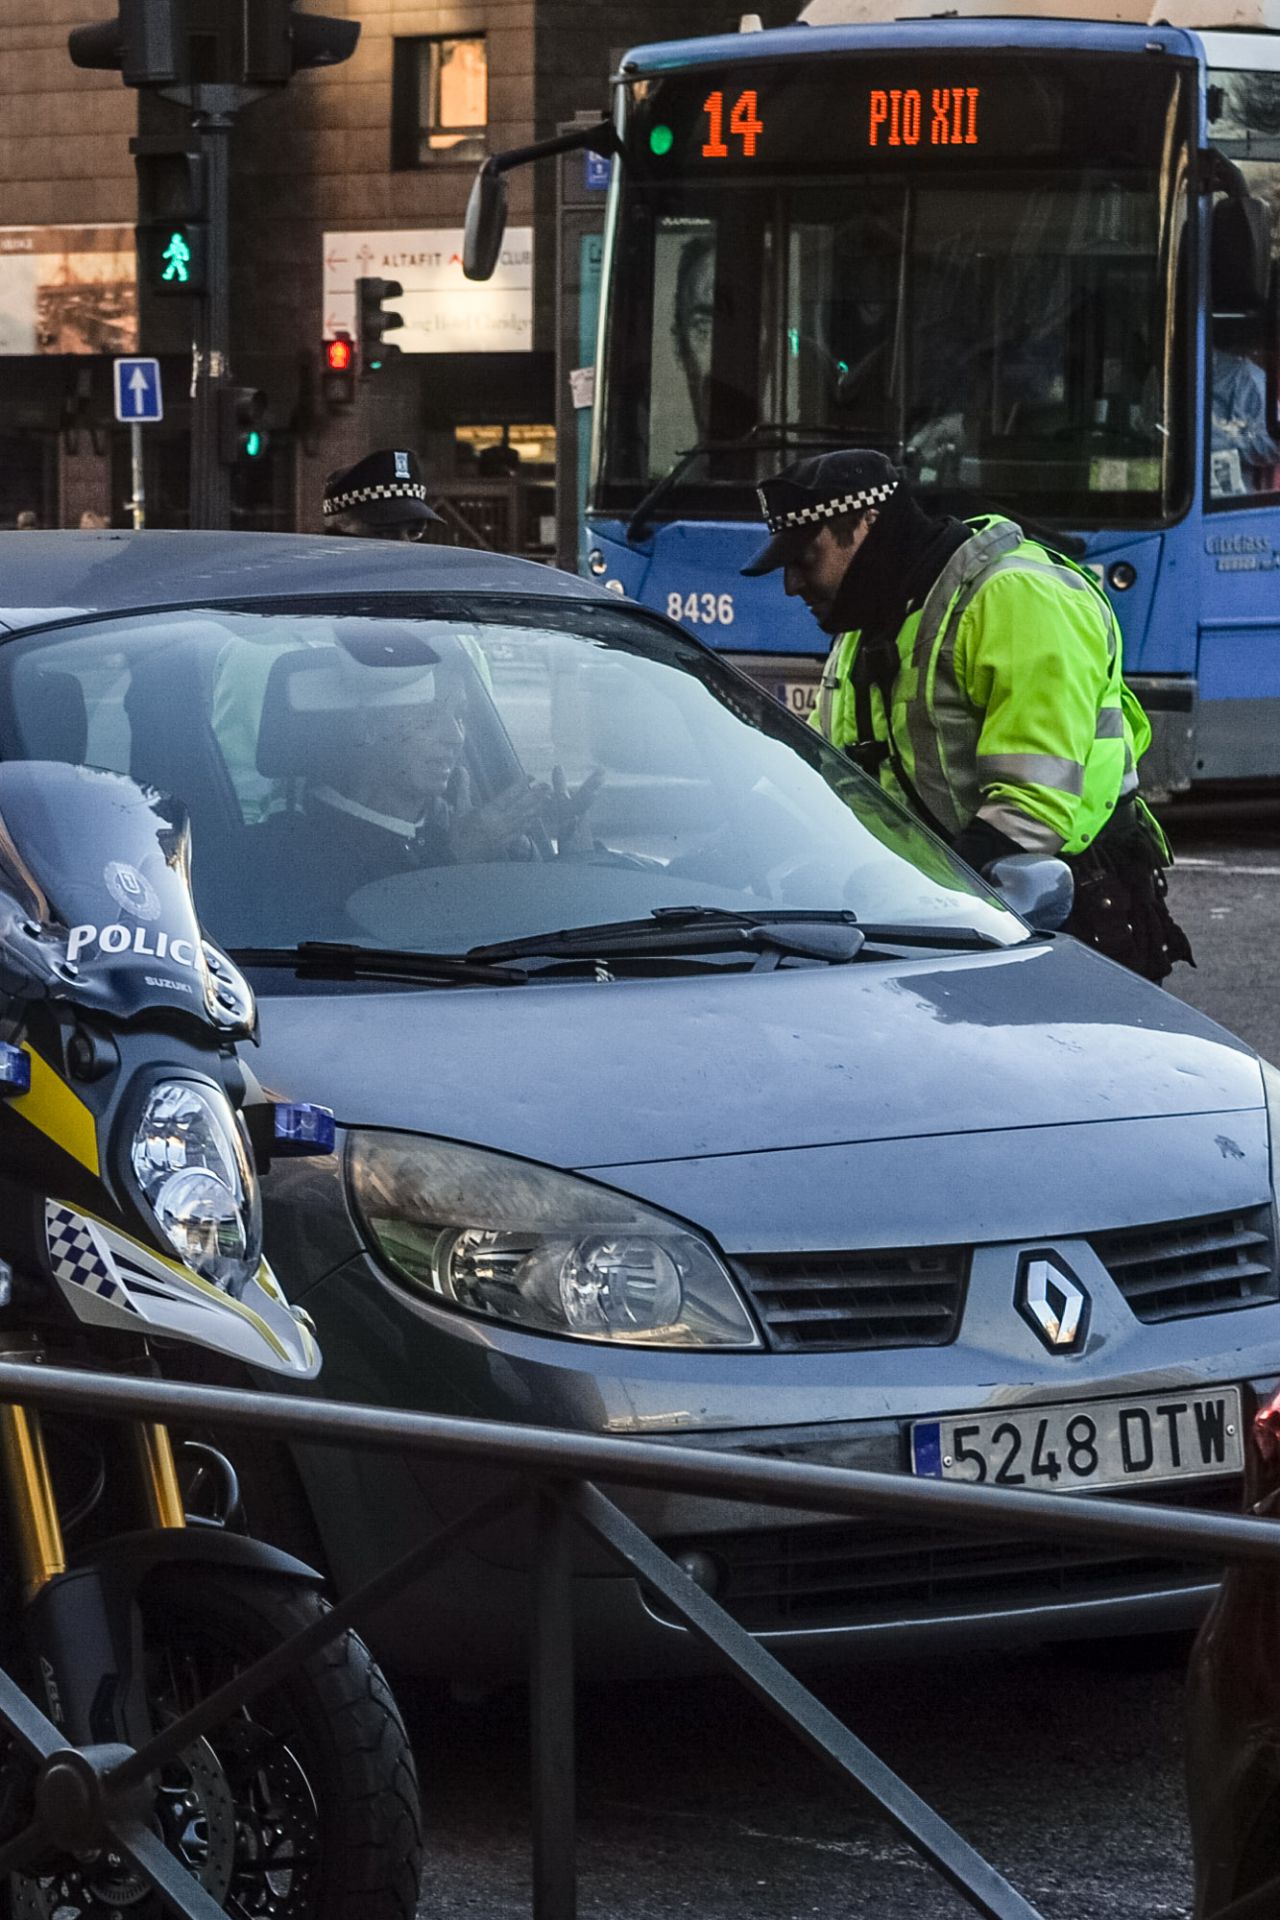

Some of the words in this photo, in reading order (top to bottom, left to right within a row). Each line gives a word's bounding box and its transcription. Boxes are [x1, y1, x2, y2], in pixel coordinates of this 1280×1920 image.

[702, 91, 763, 157] 14
[869, 89, 921, 146] PIO
[931, 87, 979, 145] XII
[381, 252, 442, 268] ALTAFIT
[667, 592, 735, 625] 8436
[144, 976, 193, 994] SUZUKI
[953, 1414, 1098, 1484] 5248
[1119, 1399, 1225, 1473] DTW
